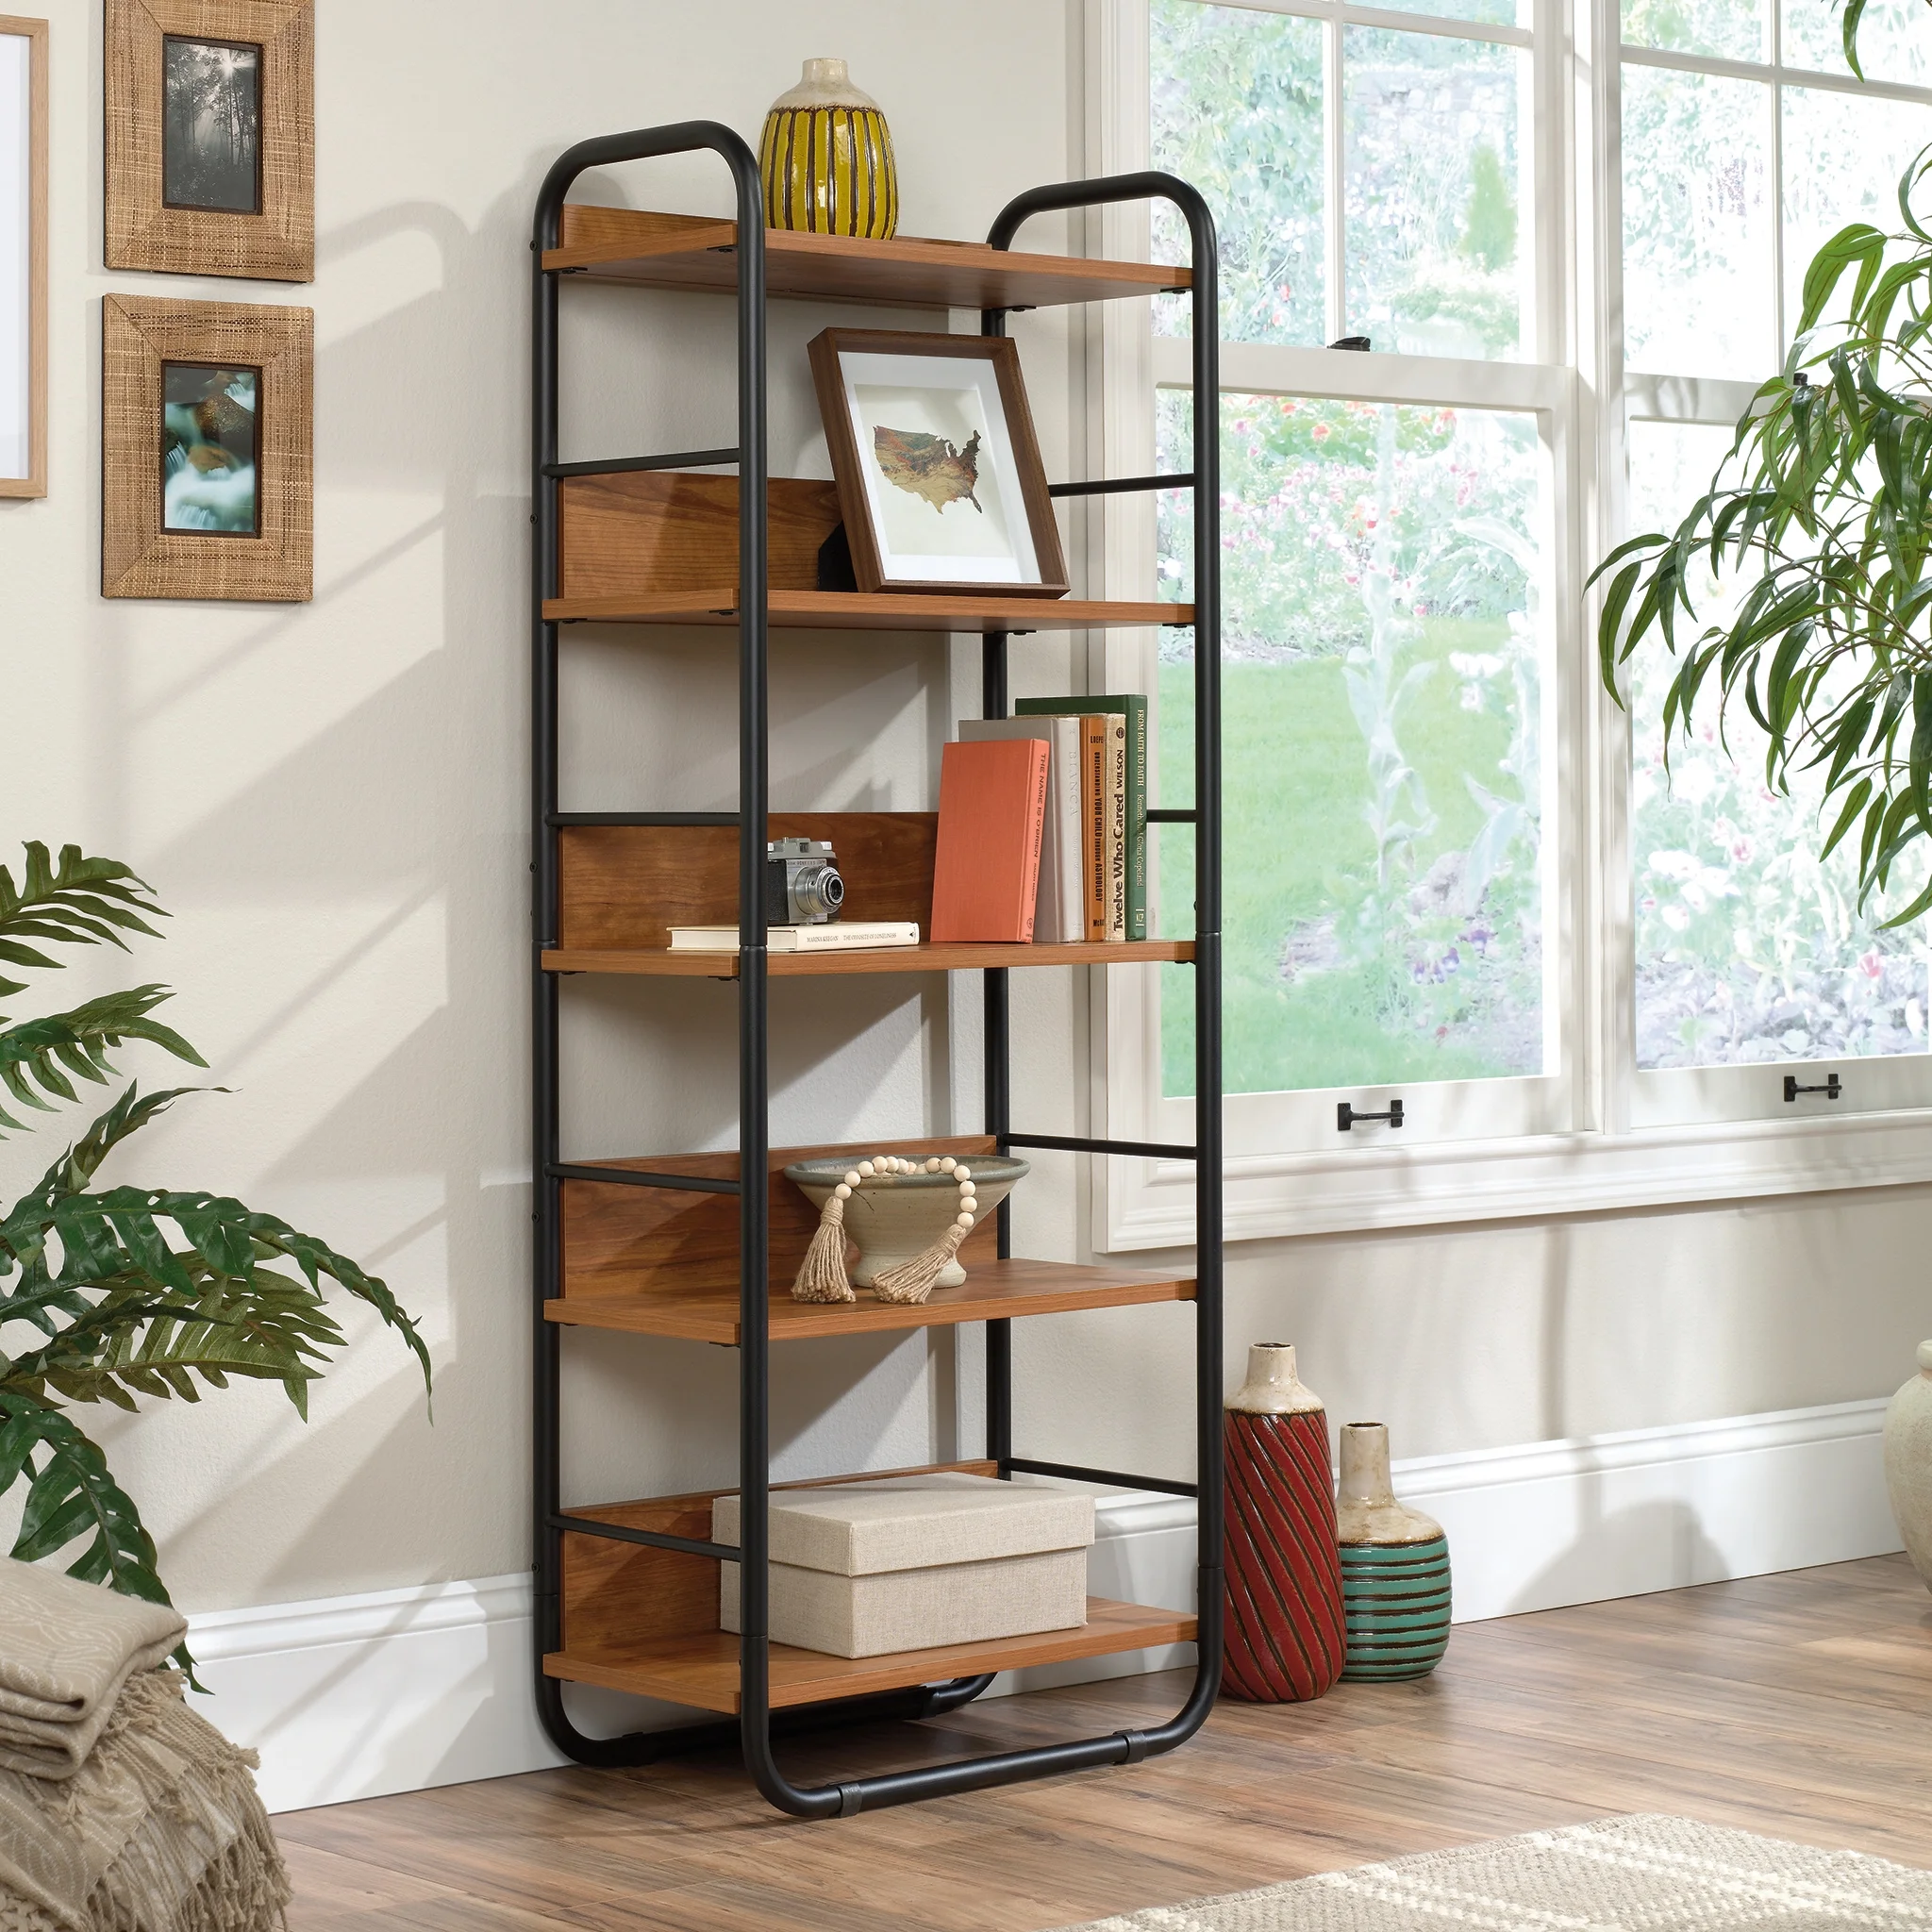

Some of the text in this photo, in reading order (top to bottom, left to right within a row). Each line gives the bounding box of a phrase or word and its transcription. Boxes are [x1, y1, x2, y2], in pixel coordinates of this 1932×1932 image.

[1138, 754, 1144, 764] TO
[1069, 751, 1078, 816] BIANCA
[1037, 807, 1042, 816] IS
[1094, 797, 1103, 815] YOUR
[1114, 793, 1124, 840] Cared
[1094, 817, 1103, 838] CHILD
[1114, 841, 1124, 879] Who
[1135, 857, 1143, 887] Copeland
[1095, 863, 1104, 902] ASTROLOGY
[1114, 881, 1124, 932] Twelve
